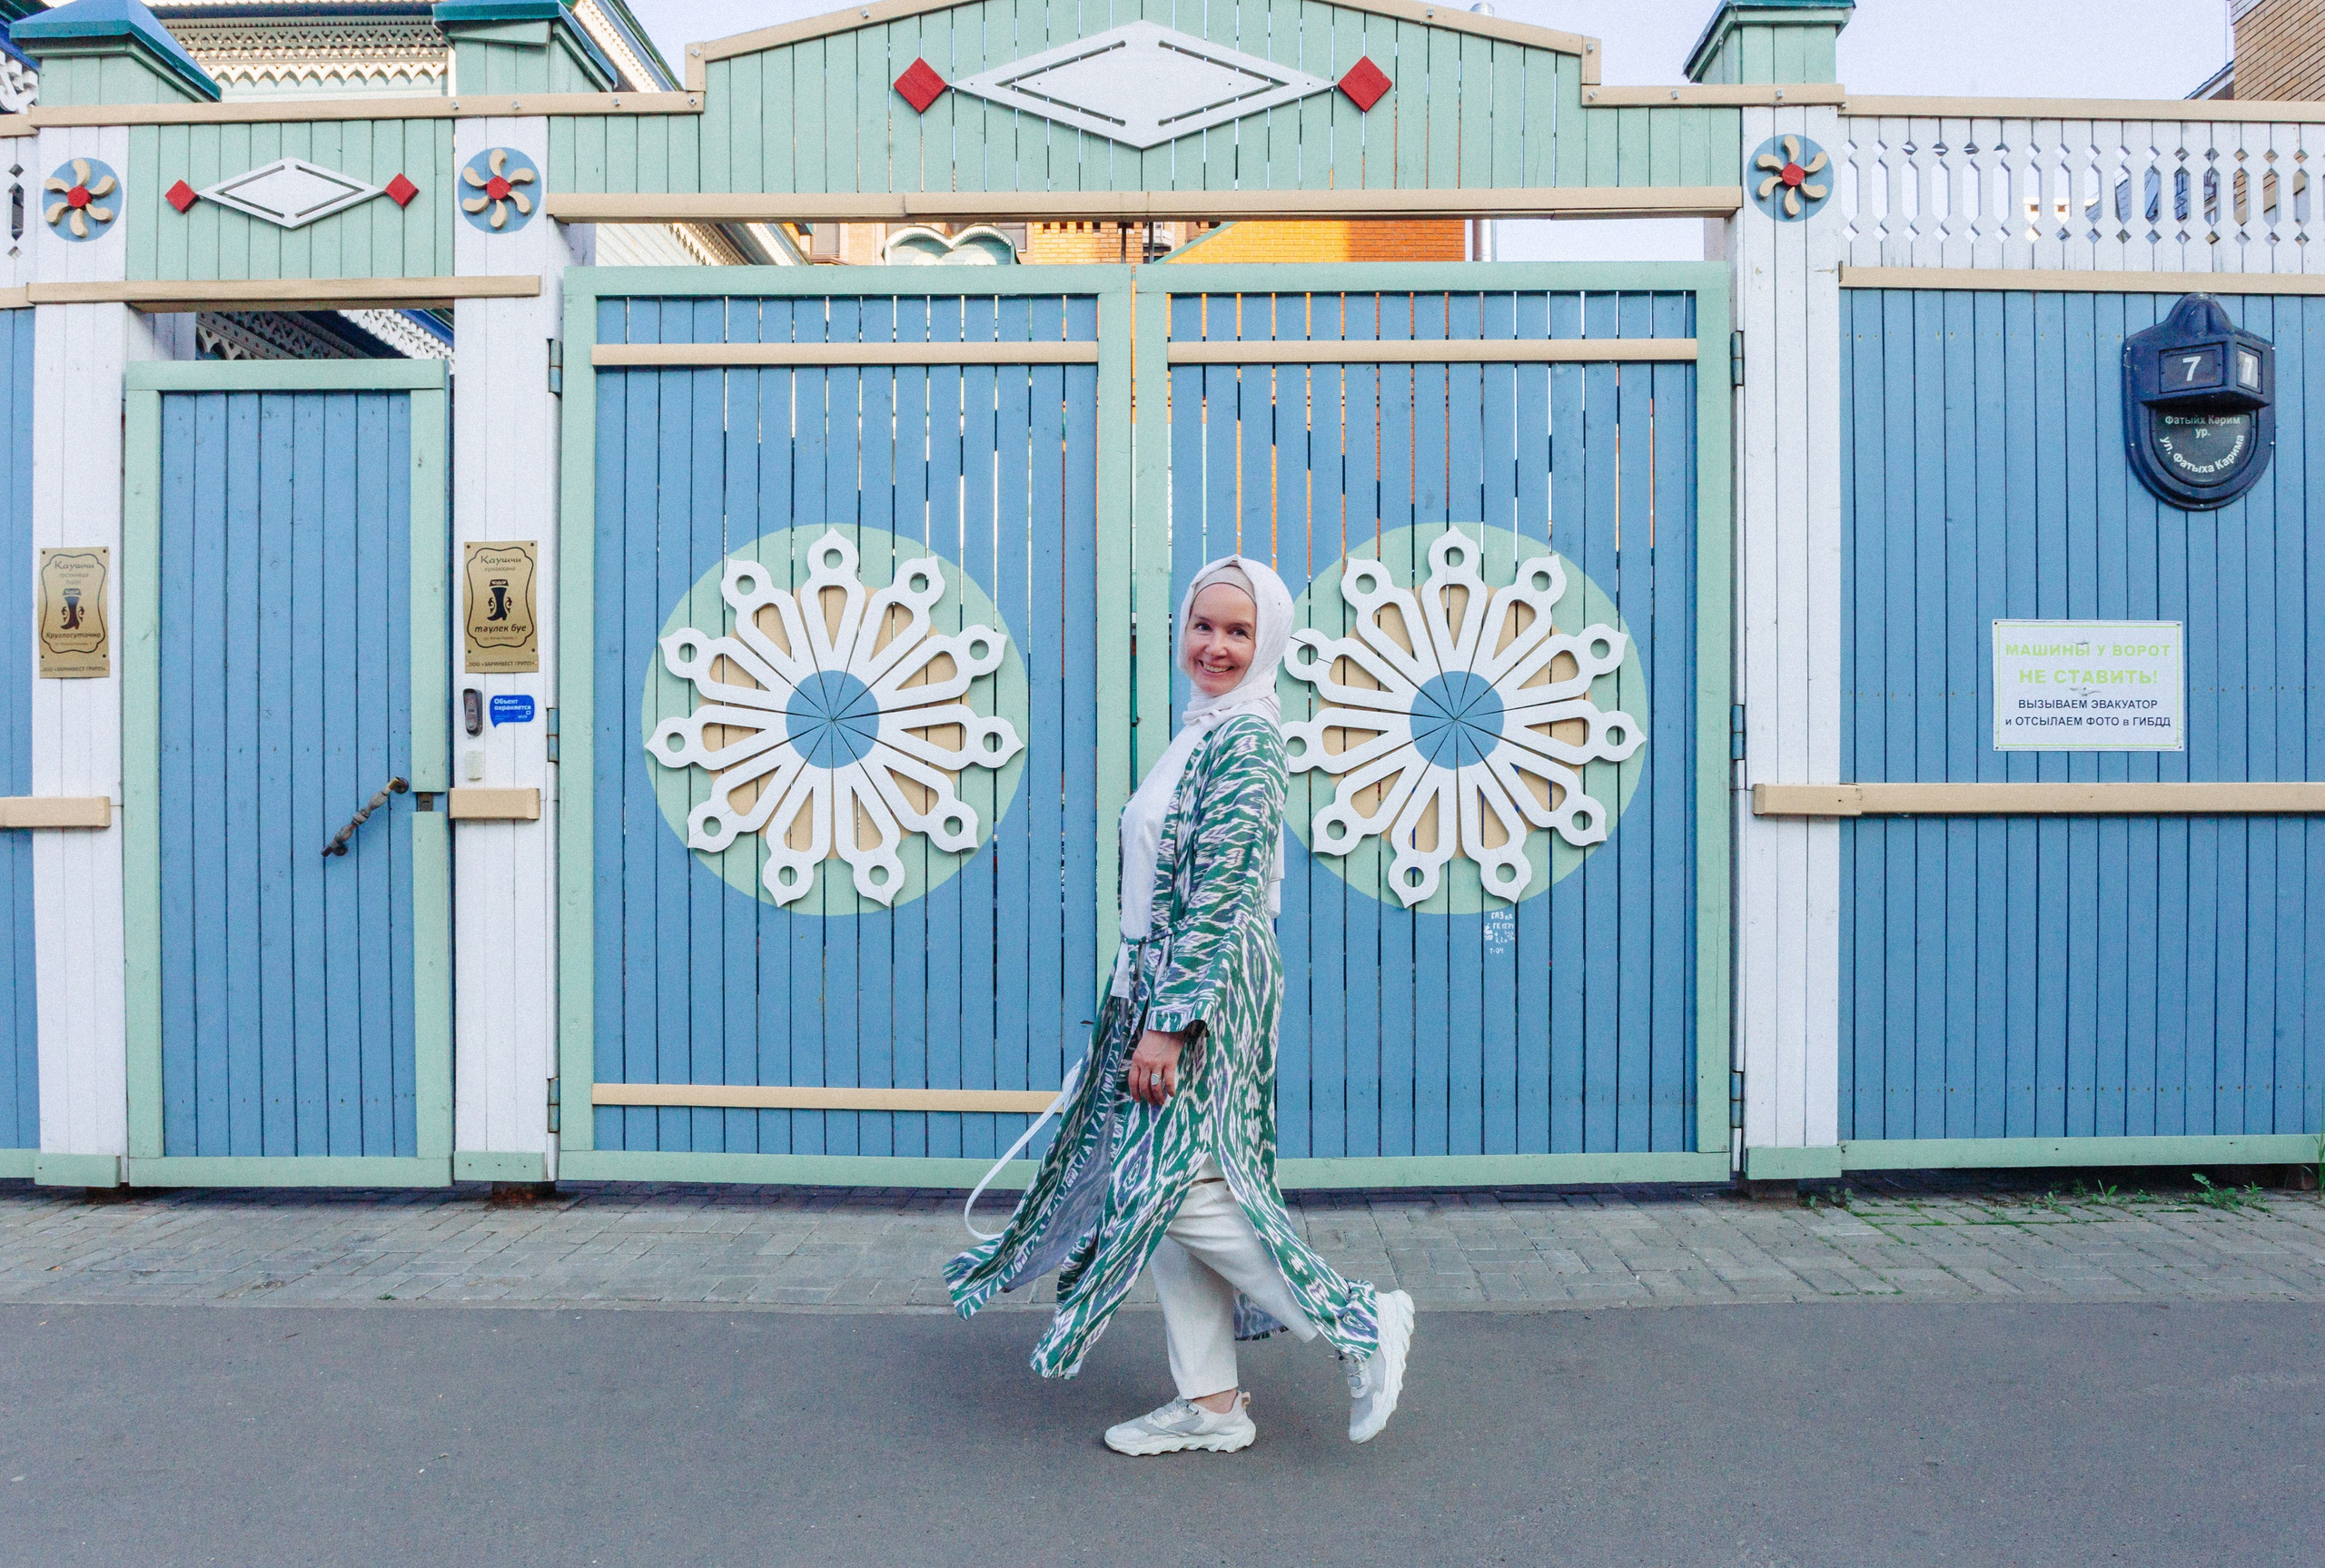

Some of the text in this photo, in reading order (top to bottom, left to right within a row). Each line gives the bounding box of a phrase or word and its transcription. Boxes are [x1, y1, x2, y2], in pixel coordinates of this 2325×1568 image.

[2182, 356, 2201, 381] 7
[2165, 415, 2205, 424] Фатыйх
[2195, 429, 2211, 438] ур.
[2160, 435, 2244, 473] ул. Фатыха Карима
[480, 556, 521, 566] Каушчи
[2005, 645, 2171, 656] МАШИНЫ У ВОРОТ
[2019, 670, 2158, 684] НЕ СТАВИТЬ!
[2018, 700, 2158, 708] ВЫЗЫВАЕМ ЭВАКУАТОР
[2015, 717, 2083, 726] ОТСЫЛАЕМ
[2086, 717, 2120, 726] ФОТО
[2132, 717, 2171, 726] ГИБДД
